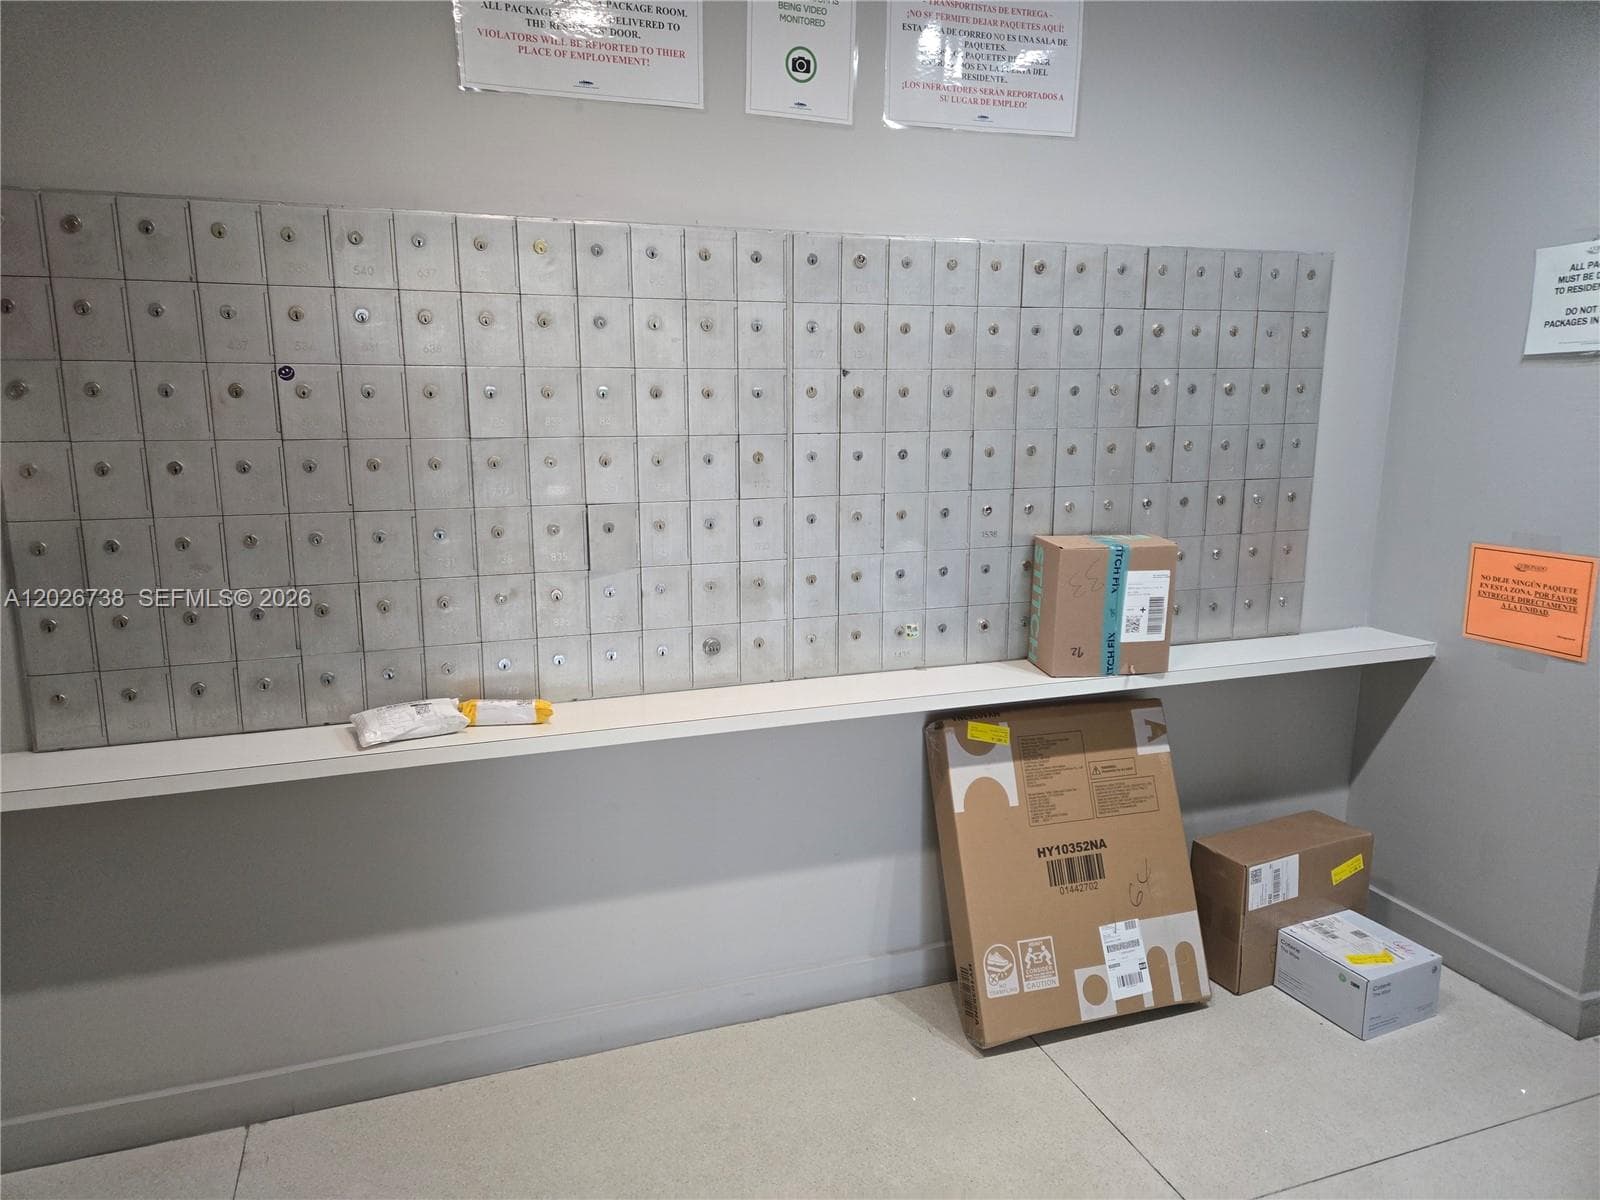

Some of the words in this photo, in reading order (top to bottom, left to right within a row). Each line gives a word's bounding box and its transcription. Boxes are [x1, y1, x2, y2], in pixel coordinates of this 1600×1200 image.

[481, 0, 502, 11] ALL
[667, 22, 681, 32] TO
[606, 0, 653, 13] PACKAGE
[655, 6, 688, 18] ROOM.
[778, 0, 802, 13] BEING
[803, 4, 828, 16] VIDEO
[998, 6, 1010, 14] DE
[1011, 7, 1049, 18] ENTREGA
[779, 13, 826, 27] MONITORED
[935, 12, 970, 25] PERMITE
[972, 17, 998, 27] DEJAR
[1000, 20, 1041, 31] PAQUETES
[525, 18, 546, 29] THE
[610, 28, 641, 39] DOOR.
[902, 22, 923, 33] ESTA
[946, 27, 958, 36] DE
[958, 29, 993, 40] CORREO
[994, 33, 1006, 41] NO
[1007, 34, 1017, 42] ES
[1018, 35, 1035, 44] UNA
[1036, 37, 1056, 46] SALA
[1057, 38, 1069, 47] DE
[477, 27, 538, 42] VIOLATORS
[540, 35, 567, 47] WILL
[570, 39, 583, 48] BE
[585, 41, 638, 54] REPORTED
[640, 46, 654, 56] TO
[656, 47, 686, 59] THIER
[964, 41, 1007, 52] PAQUETES.
[517, 45, 551, 57] PLACE
[554, 48, 568, 58] OF
[570, 50, 650, 66] EMPLOYEMENT!
[965, 51, 1007, 62] PAQUETES
[1033, 68, 1049, 77] DEL
[922, 82, 978, 94] INFRACTORES
[1006, 90, 1058, 101] REPORTADOS
[939, 94, 950, 103] SU
[951, 95, 979, 105] LUGAR
[979, 98, 991, 106] DE
[353, 265, 375, 276] 540
[1569, 263, 1586, 272] ALL
[1558, 274, 1581, 283] MUST
[1582, 272, 1595, 281] BE
[1554, 287, 1566, 295] TO
[1565, 307, 1578, 316] DO
[1580, 305, 1598, 315] NOT
[1543, 317, 1588, 328] PACKAGES
[1111, 577, 1120, 593] FIX
[1481, 574, 1491, 582] NO
[1492, 576, 1510, 584] DEJE
[1543, 583, 1578, 595] PAQUETE
[1490, 583, 1508, 592] ESTA
[1534, 590, 1549, 599] POR
[1551, 593, 1578, 603] FAVOR
[1028, 543, 1044, 664] STITCH
[1478, 590, 1517, 602] ENTREGUE
[1517, 596, 1578, 613] DIRECTAMENTE
[1107, 632, 1116, 649] FIX
[1037, 838, 1107, 858] HY10352NA
[1059, 881, 1099, 895] 01442702
[1026, 979, 1057, 990] CAUTION
